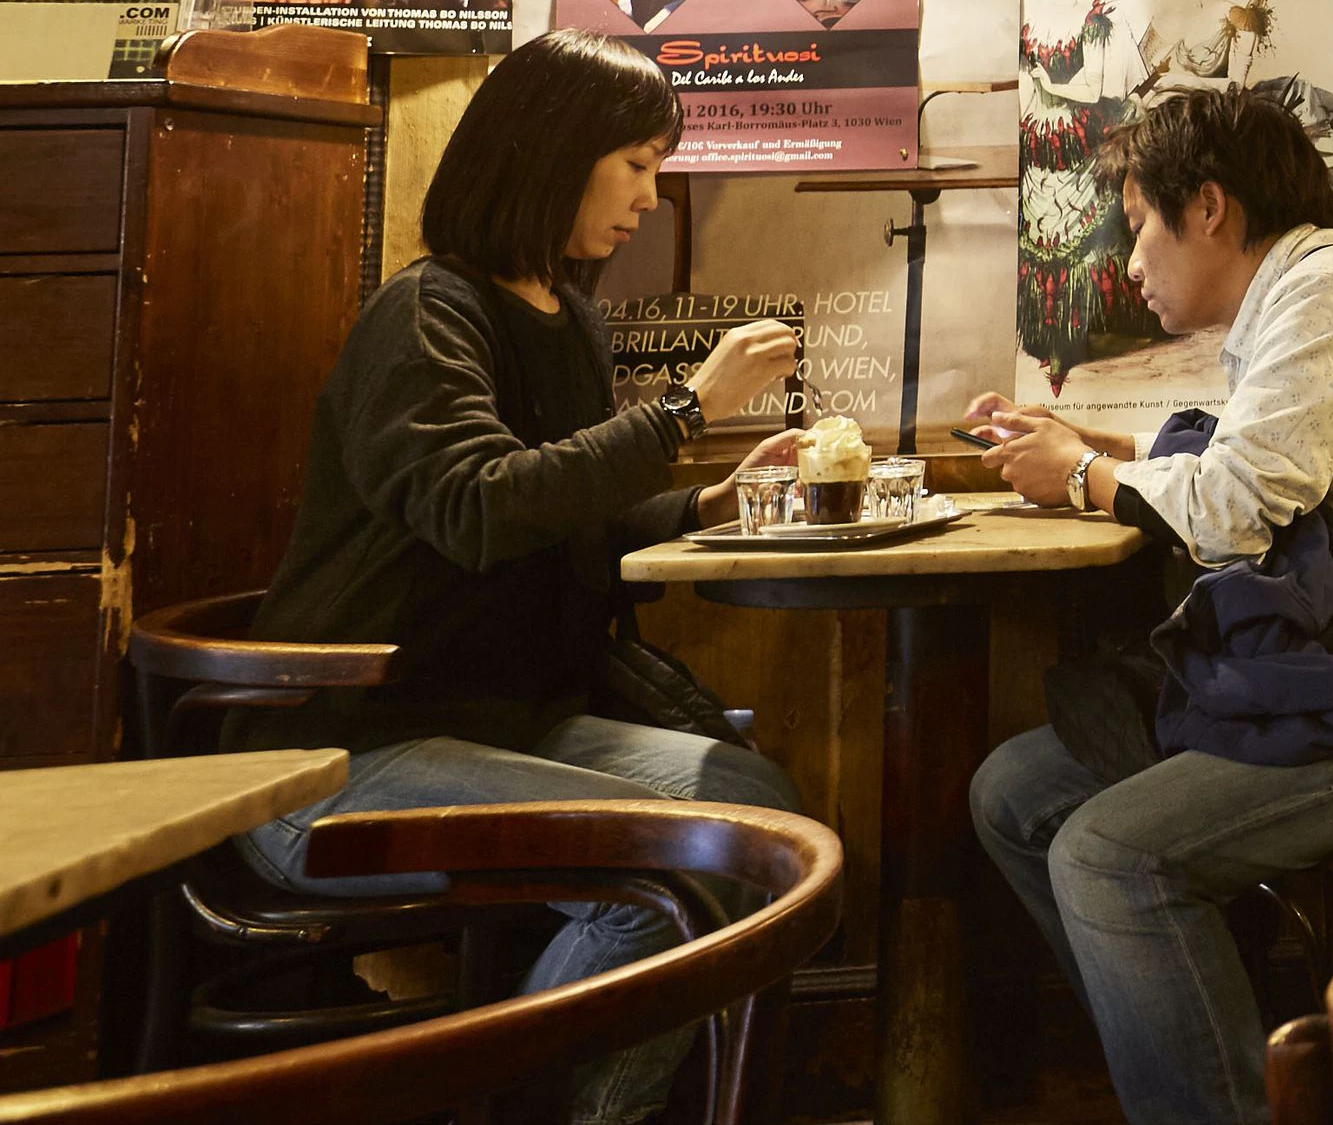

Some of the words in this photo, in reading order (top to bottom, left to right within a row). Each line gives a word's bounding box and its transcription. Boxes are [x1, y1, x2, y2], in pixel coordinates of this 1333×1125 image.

[386, 9, 436, 18] THOMAS
[459, 10, 508, 19] NILSSON
[656, 40, 821, 69] Spirituosi
[671, 71, 691, 86] Del
[694, 71, 733, 85] Caribe
[736, 74, 744, 84] a
[747, 70, 766, 84] los
[769, 68, 804, 84] Andes
[696, 104, 744, 119] 2016,
[749, 102, 797, 117] 19:30
[801, 102, 832, 115] Uhr
[844, 117, 870, 128] 1030
[873, 117, 902, 127] Wien
[744, 296, 803, 317] UHR:
[814, 291, 892, 314] HOTEL
[1086, 399, 1137, 412] angewandte
[1140, 399, 1164, 409] Kunst
